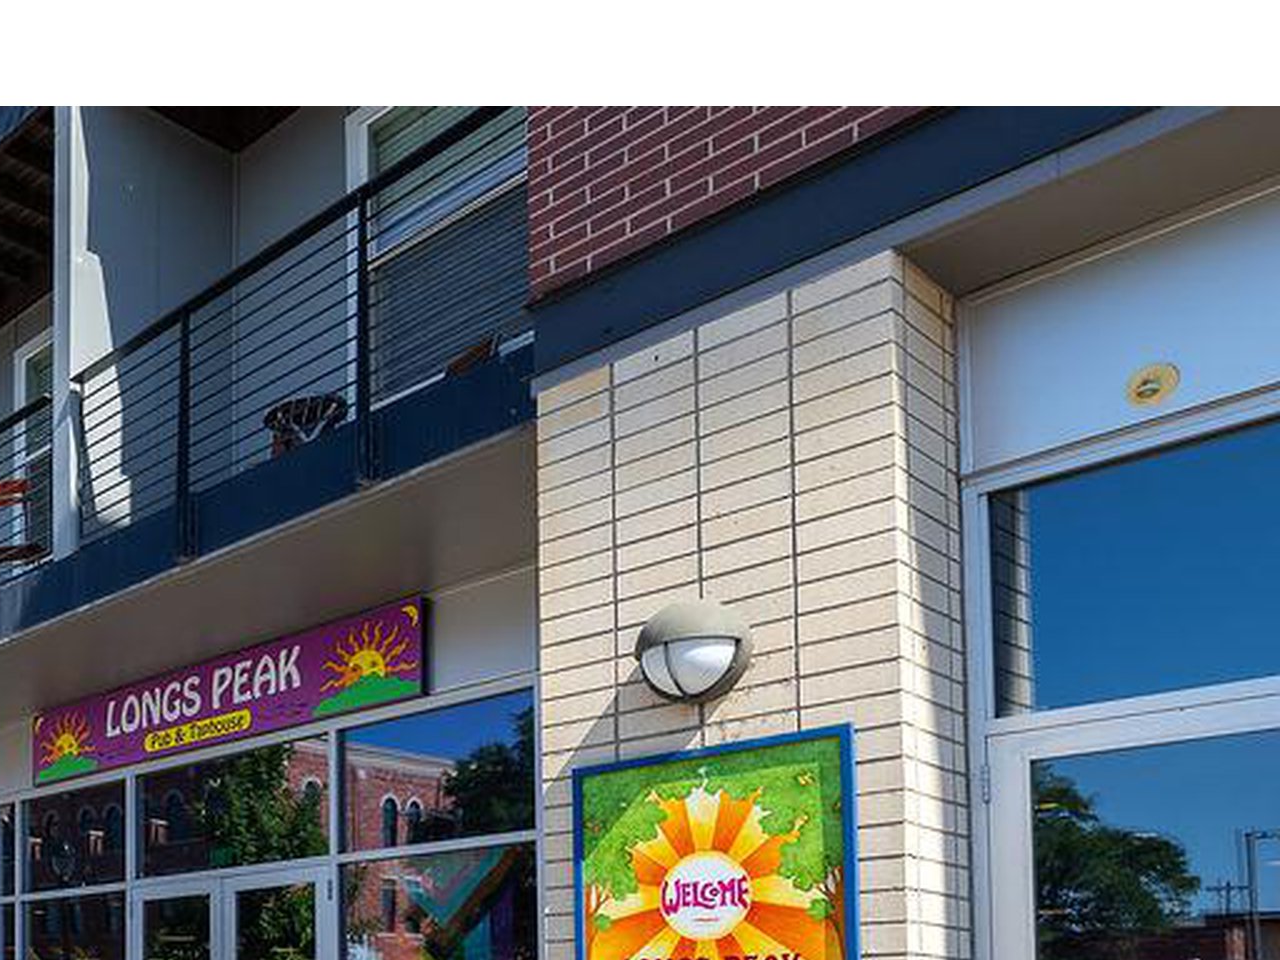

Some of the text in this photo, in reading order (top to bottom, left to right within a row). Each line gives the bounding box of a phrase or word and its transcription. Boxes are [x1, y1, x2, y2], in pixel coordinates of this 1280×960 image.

[106, 645, 301, 738] LONGS PEAK
[662, 876, 751, 916] WELCOME
